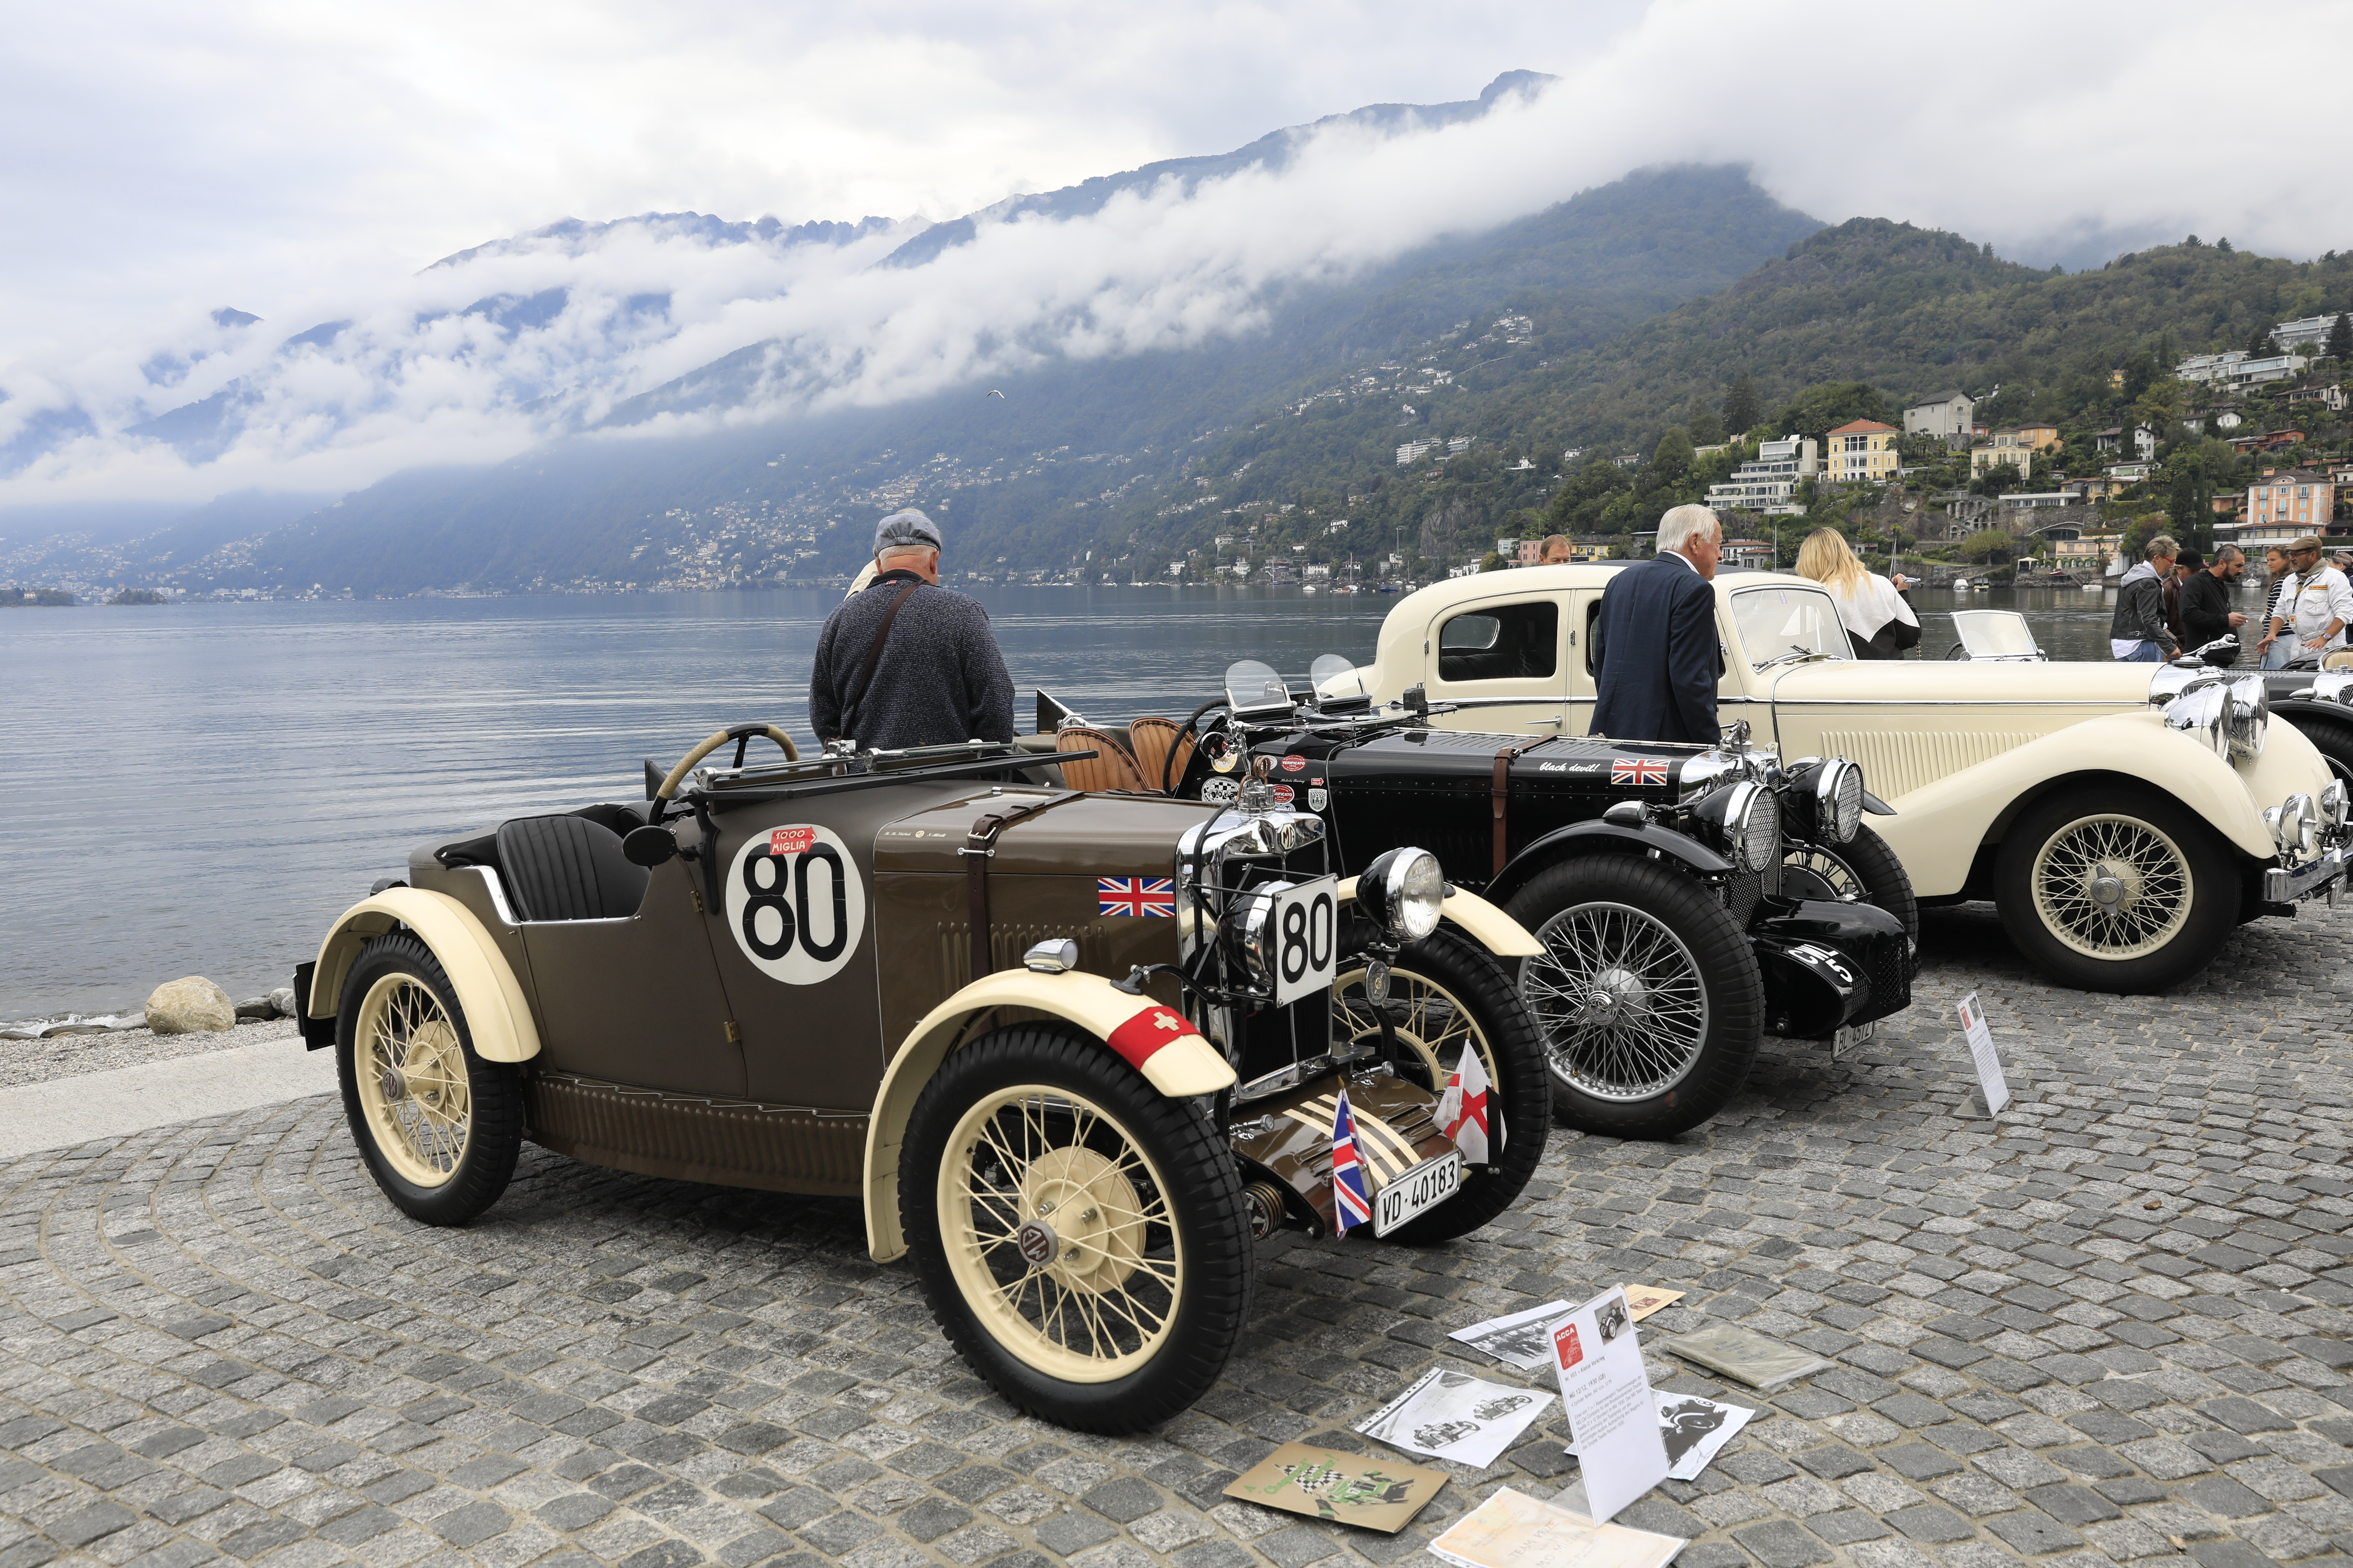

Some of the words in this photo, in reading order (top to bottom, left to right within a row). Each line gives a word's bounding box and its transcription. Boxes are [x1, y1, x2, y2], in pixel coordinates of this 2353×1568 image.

[1539, 762, 1568, 772] black
[1568, 763, 1601, 772] devil!
[772, 840, 805, 852] MIGLIA
[775, 830, 805, 840] 1000
[1282, 826, 1295, 848] MG
[743, 842, 848, 962] 80
[1281, 892, 1332, 984] 80
[1825, 959, 1853, 983] 5
[1021, 1229, 1048, 1260] MG
[1556, 1327, 1575, 1342] ACCA
[1580, 1362, 1591, 1373] Klasse
[1591, 1354, 1605, 1368] Vorkrieg
[1569, 1391, 1576, 1399] MG
[1588, 1377, 1597, 1388] 1930
[1597, 1372, 1606, 1383] (GB)
[1573, 1396, 1585, 1407] Zylinder
[1586, 1407, 1600, 1420] Company
[1632, 1380, 1642, 1390] Double
[1579, 1428, 1590, 1439] gewann
[1590, 1420, 1603, 1432] erstmalig
[1608, 1408, 1622, 1420] Teampreis
[1596, 1408, 1609, 1420] Stunden)
[1608, 1413, 1625, 1428] Aufmachung
[1629, 1402, 1640, 1413] Wagens
[1587, 1437, 1598, 1447] Double
[1606, 1424, 1617, 1435] Rennen
[1506, 1539, 1538, 1559] TEAM
[1532, 1520, 1562, 1538] PRIZE
